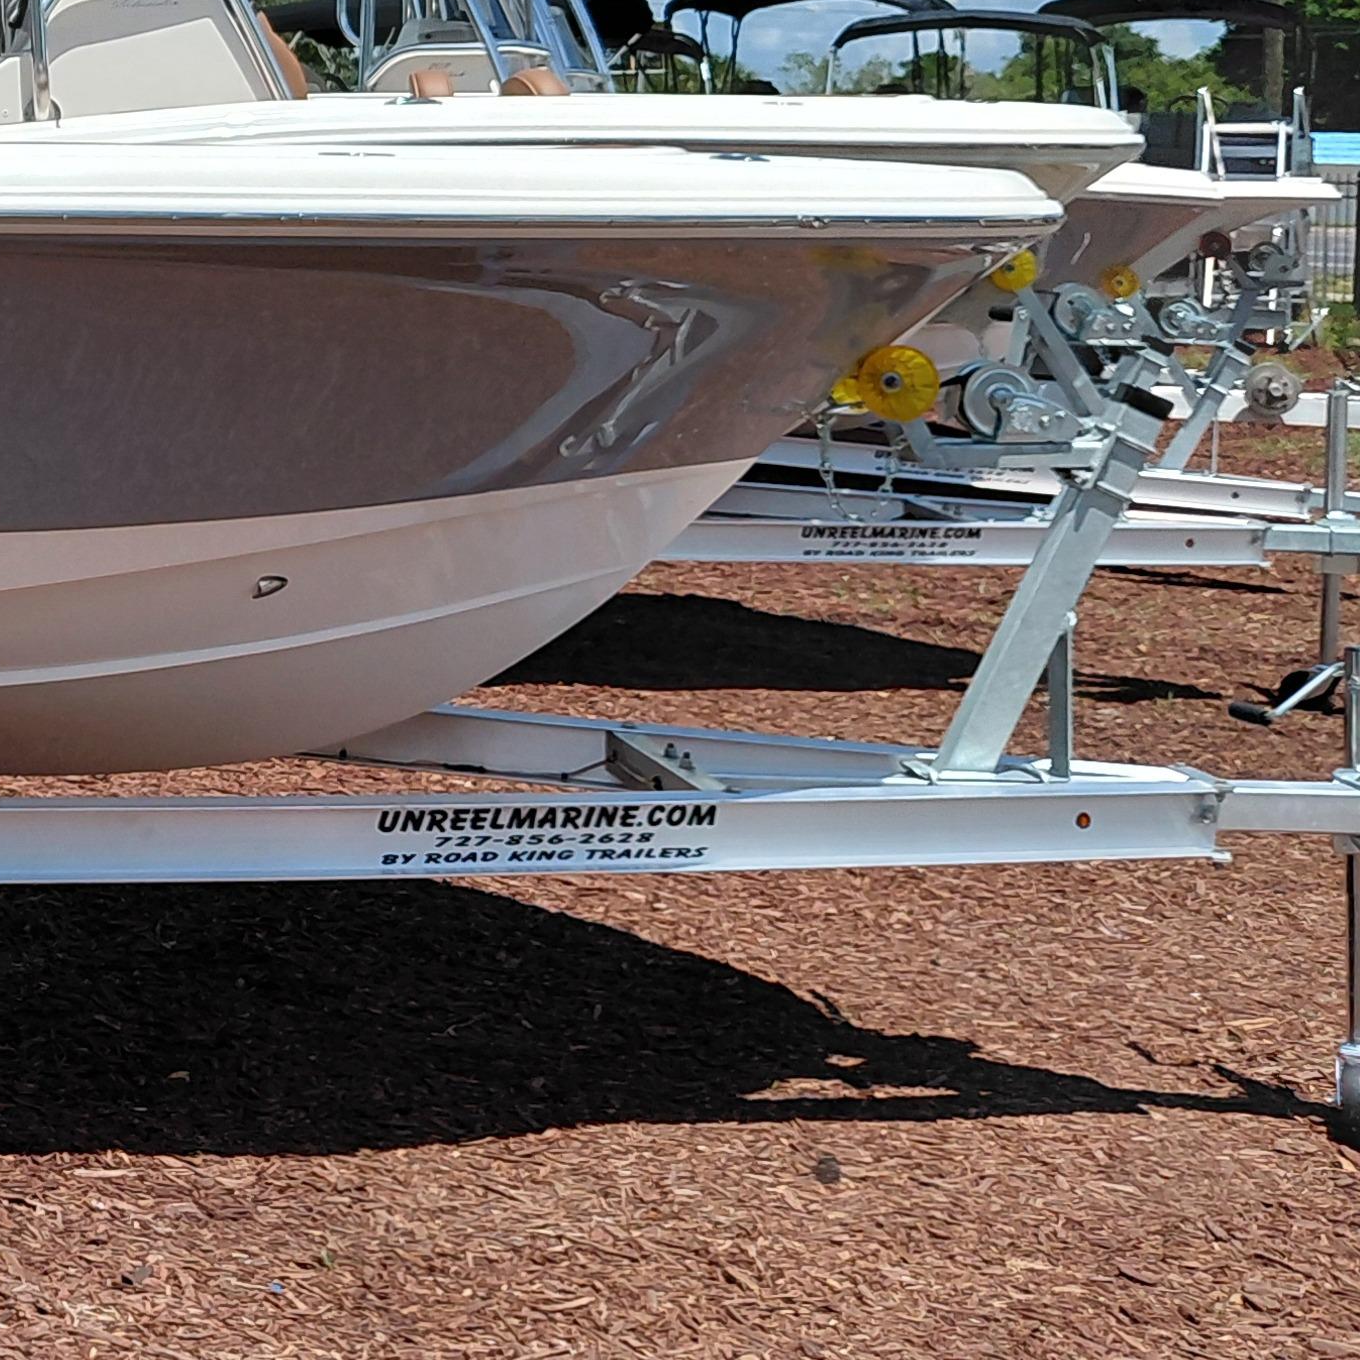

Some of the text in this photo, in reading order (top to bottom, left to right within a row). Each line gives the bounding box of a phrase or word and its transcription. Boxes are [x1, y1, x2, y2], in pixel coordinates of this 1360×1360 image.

[801, 525, 983, 540] UNREELMARINE.COM
[377, 804, 717, 834] UNREELMARINE.COM
[434, 832, 656, 848] 727-856-2628
[381, 847, 709, 866] BY ROAD KING TRAILERS
